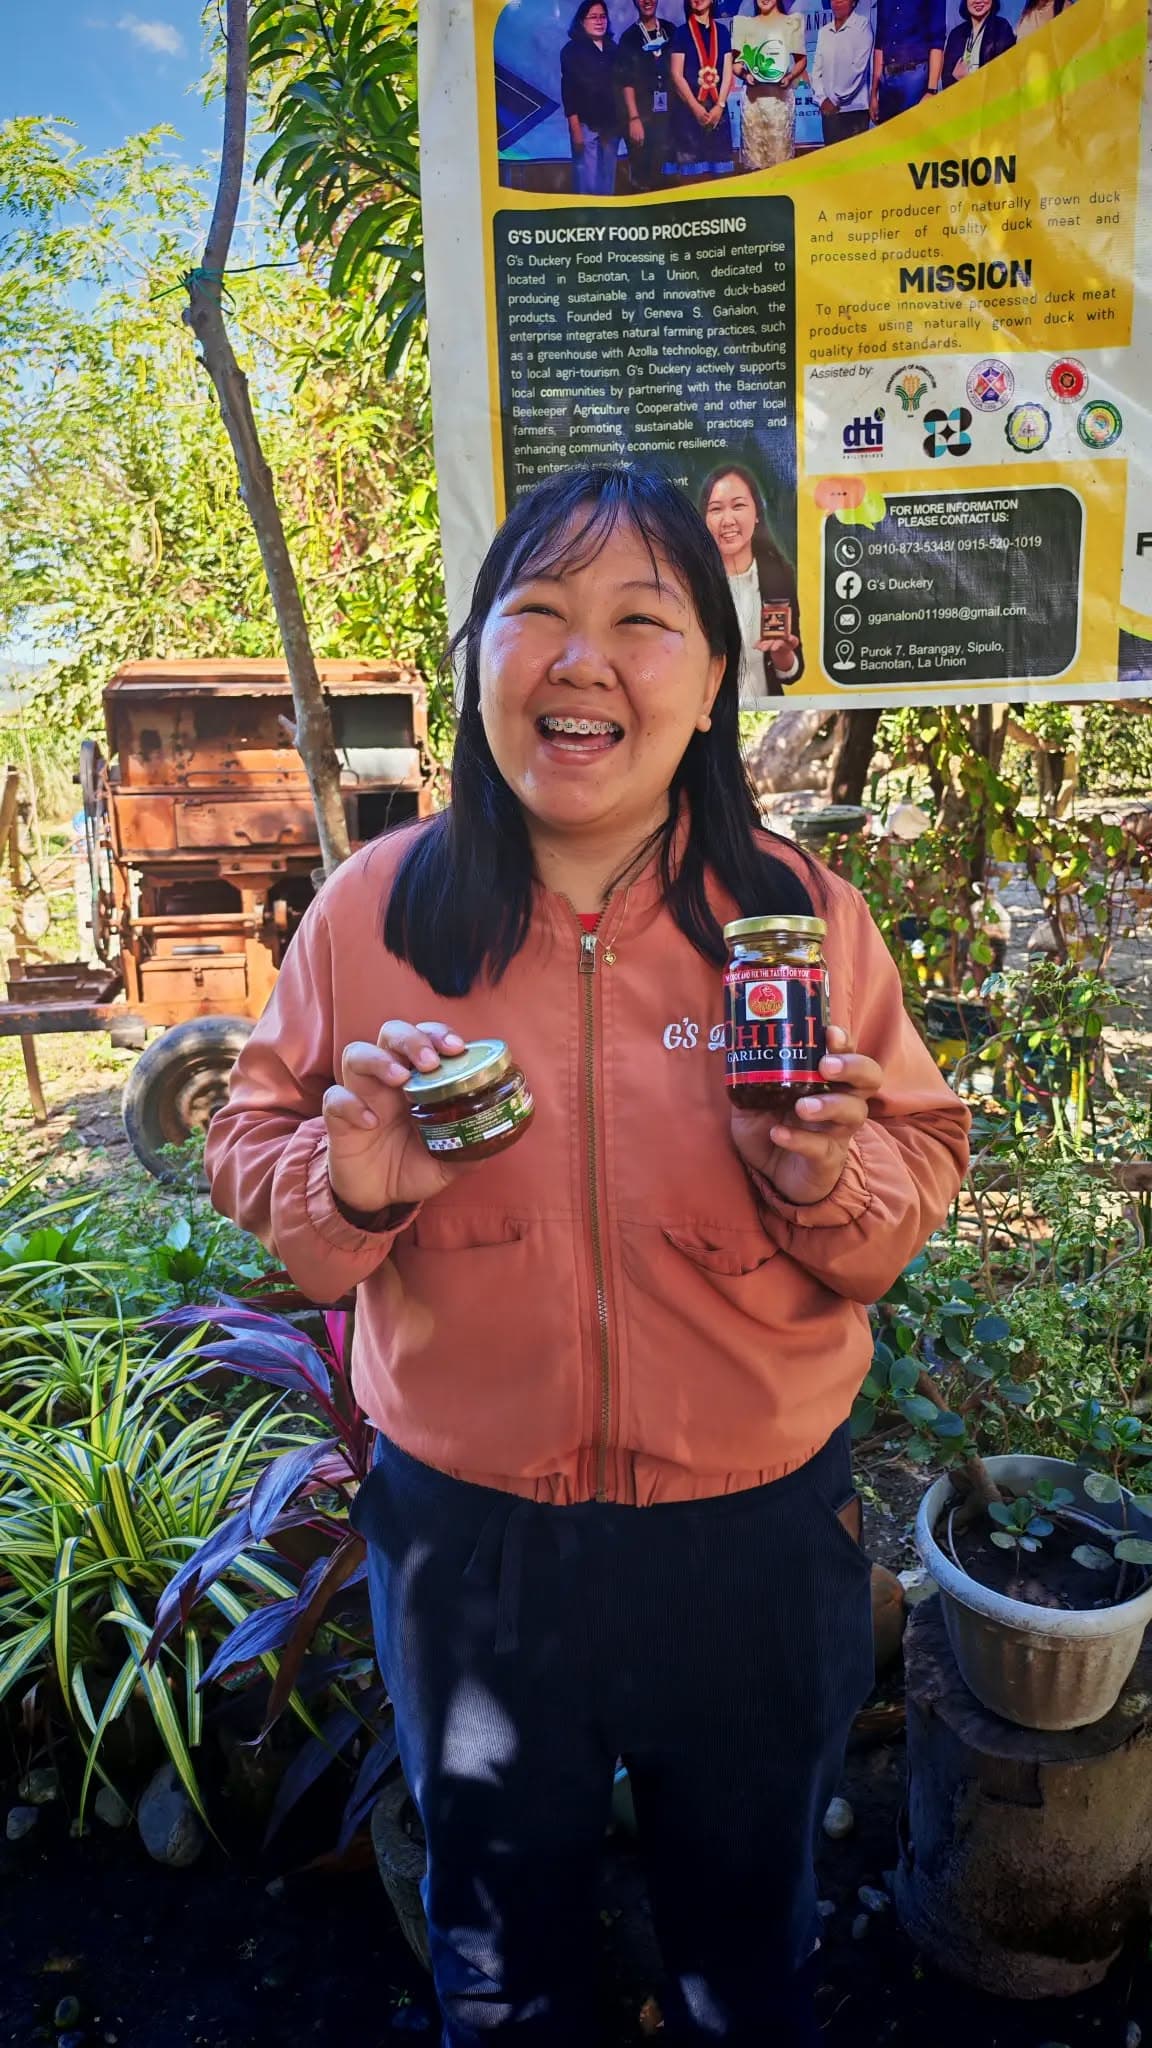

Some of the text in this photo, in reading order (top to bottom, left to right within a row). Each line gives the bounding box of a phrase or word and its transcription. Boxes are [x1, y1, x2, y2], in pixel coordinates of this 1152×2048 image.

[908, 155, 1016, 190] VISION
[818, 192, 1120, 223] A major producer of naturally grown duck
[508, 217, 746, 244] G'S DUCKERY FOOD PROCESSING
[810, 212, 1120, 243] and supplier of quality duck meat and
[507, 242, 785, 268] G's Duckery Food Processing is a social enterprise
[810, 247, 943, 264] processed products.
[508, 262, 785, 285] located in Bacnotan, La Union, dedicated to
[899, 259, 1032, 293] MISSION
[508, 281, 785, 307] producing sustainable and innovative duck-based
[816, 288, 1116, 315] To produce innovative processed duck meat
[567, 310, 612, 322] Founded
[622, 309, 634, 323] by
[644, 307, 683, 320] Geneva
[693, 308, 702, 319] S.
[769, 302, 785, 312] the
[510, 330, 562, 343] enterprise
[567, 329, 619, 342] integrates
[623, 326, 660, 339] natural
[664, 326, 703, 340] farming
[761, 321, 785, 332] such
[810, 308, 1114, 339] products using naturally grown duck with
[510, 341, 786, 362] as a greenhouse with Azolla technology, contributing
[810, 338, 961, 360] quality food standards.
[511, 369, 522, 379] to
[528, 367, 550, 378] local
[627, 365, 643, 376] G's
[649, 363, 691, 376] Duckery
[696, 362, 734, 375] actively
[740, 361, 786, 374] supports
[809, 365, 856, 379] Assisted
[512, 380, 786, 398] local communities by partnering with the Bacnotan
[513, 399, 786, 419] Beekeeper Agriculture Cooperative and other local
[635, 420, 693, 432] sustainable
[707, 418, 753, 431] practices
[768, 416, 786, 427] and
[843, 407, 884, 446] dti
[514, 437, 728, 457] enhancing community economic resilience.
[516, 463, 534, 475] The
[890, 499, 1018, 516] FOR MORE INFORMATION
[898, 512, 1009, 527] PLEASE CONTACT US:
[958, 536, 1041, 551] 0915-520-1019
[867, 577, 933, 592] G's Duckery
[868, 605, 1026, 625] gganalon011998@gmail.com
[861, 646, 892, 658] Purok
[895, 645, 905, 656] 7,
[967, 641, 1004, 653] Sipulo,
[860, 656, 966, 670] Bacnotan, La Union
[724, 1017, 817, 1050] CHILI
[727, 1049, 807, 1063] GARLIC OIL
